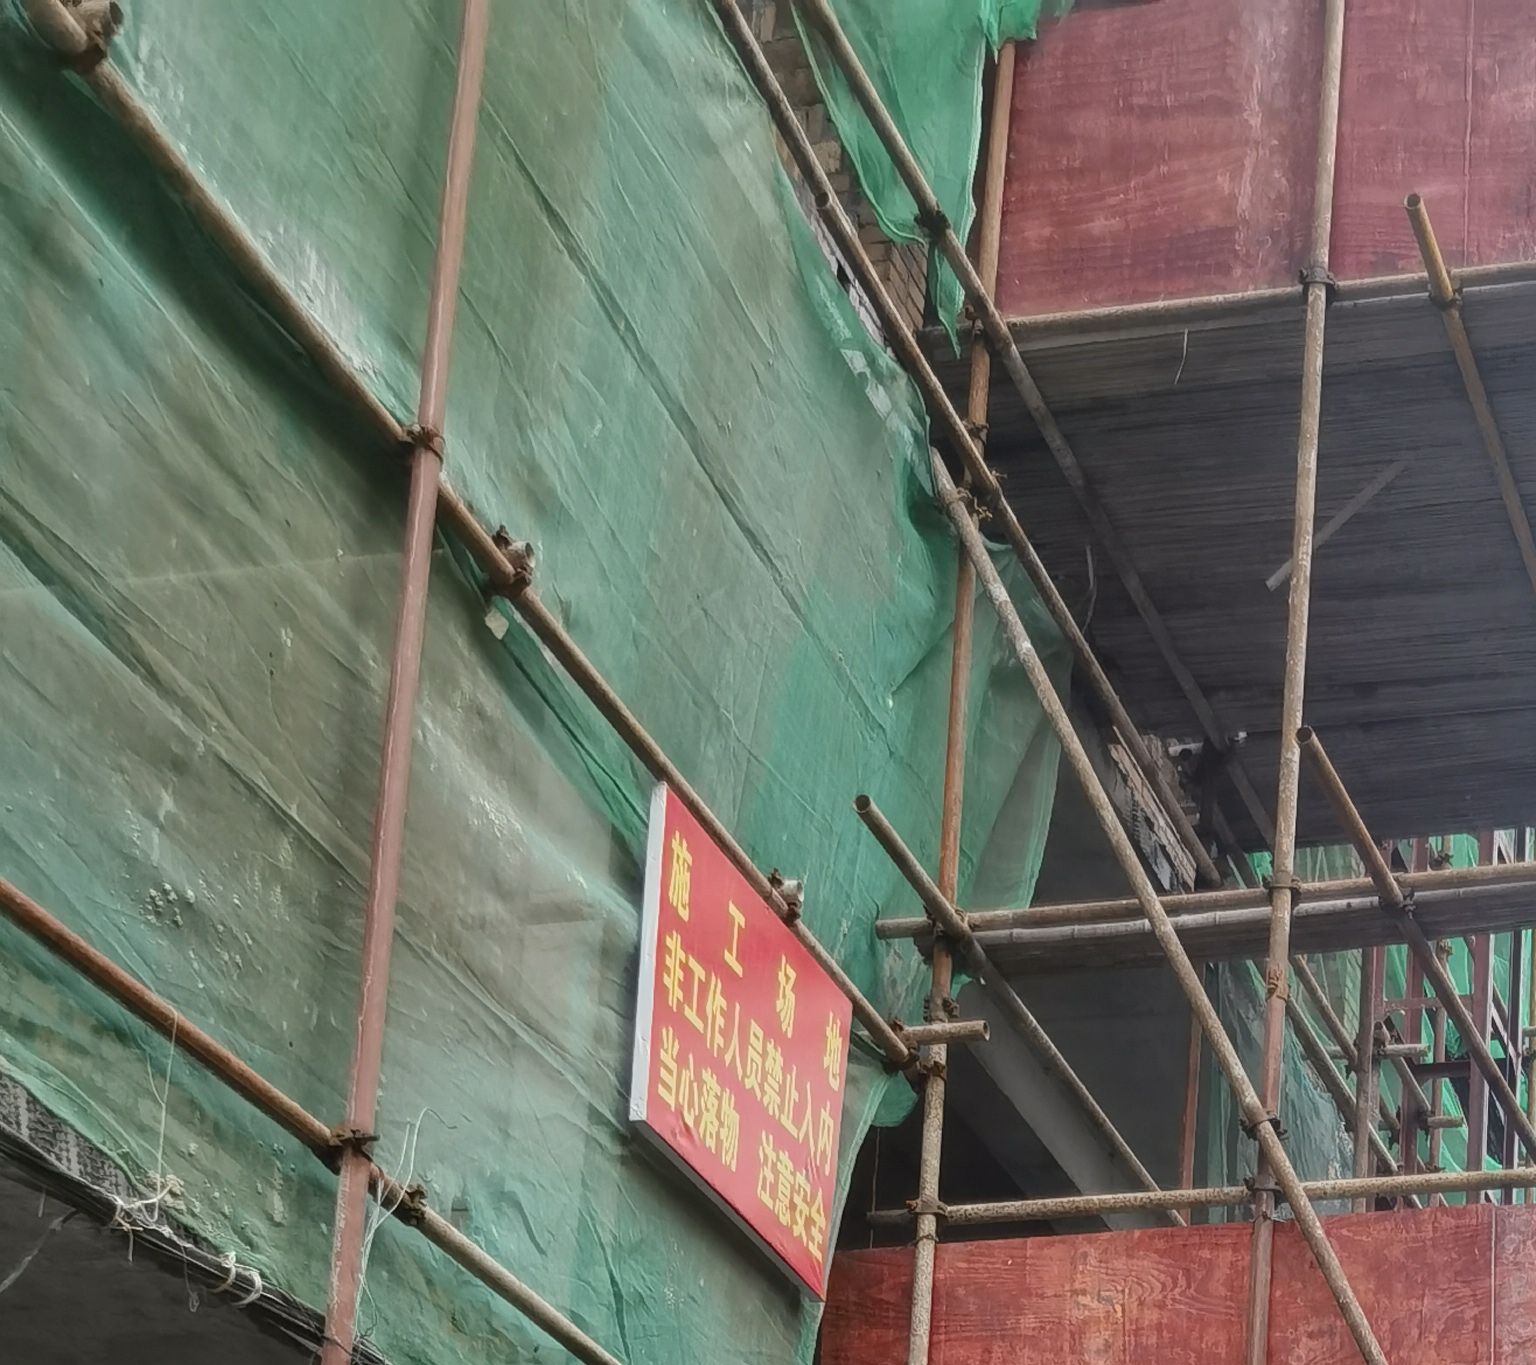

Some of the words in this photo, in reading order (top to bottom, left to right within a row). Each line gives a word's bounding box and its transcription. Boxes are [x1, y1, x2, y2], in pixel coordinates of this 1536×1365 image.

[662, 930, 833, 1177] 非工作人员禁止入内
[668, 831, 842, 1092] 施工场地
[659, 1026, 740, 1172] 当心落物
[758, 1130, 826, 1263] 注意安全
